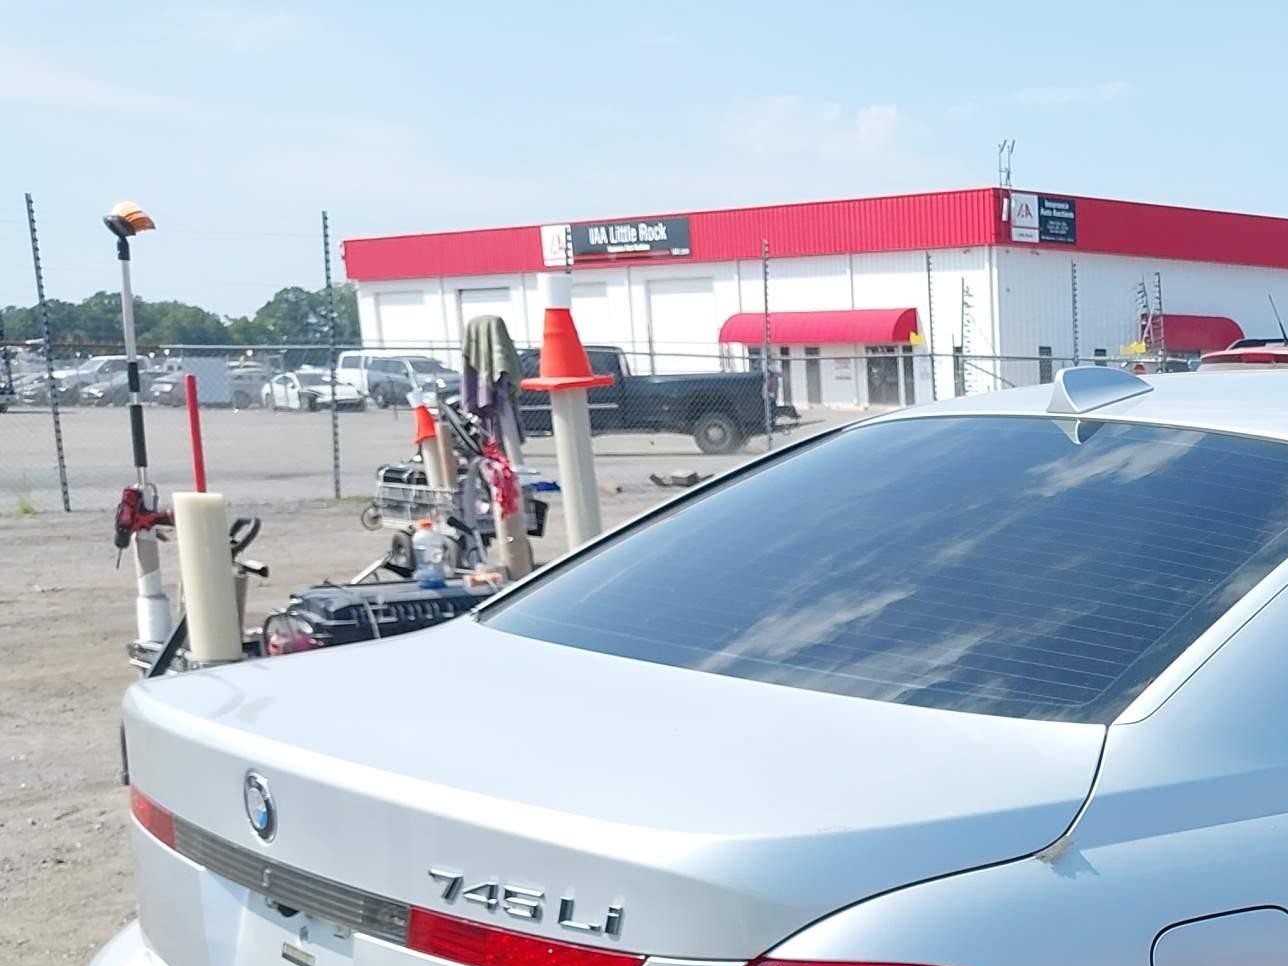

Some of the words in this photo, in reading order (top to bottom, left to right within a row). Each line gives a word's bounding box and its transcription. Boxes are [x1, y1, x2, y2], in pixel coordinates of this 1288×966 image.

[588, 226, 608, 244] IAA
[608, 225, 638, 243] Little
[638, 222, 667, 242] Rock
